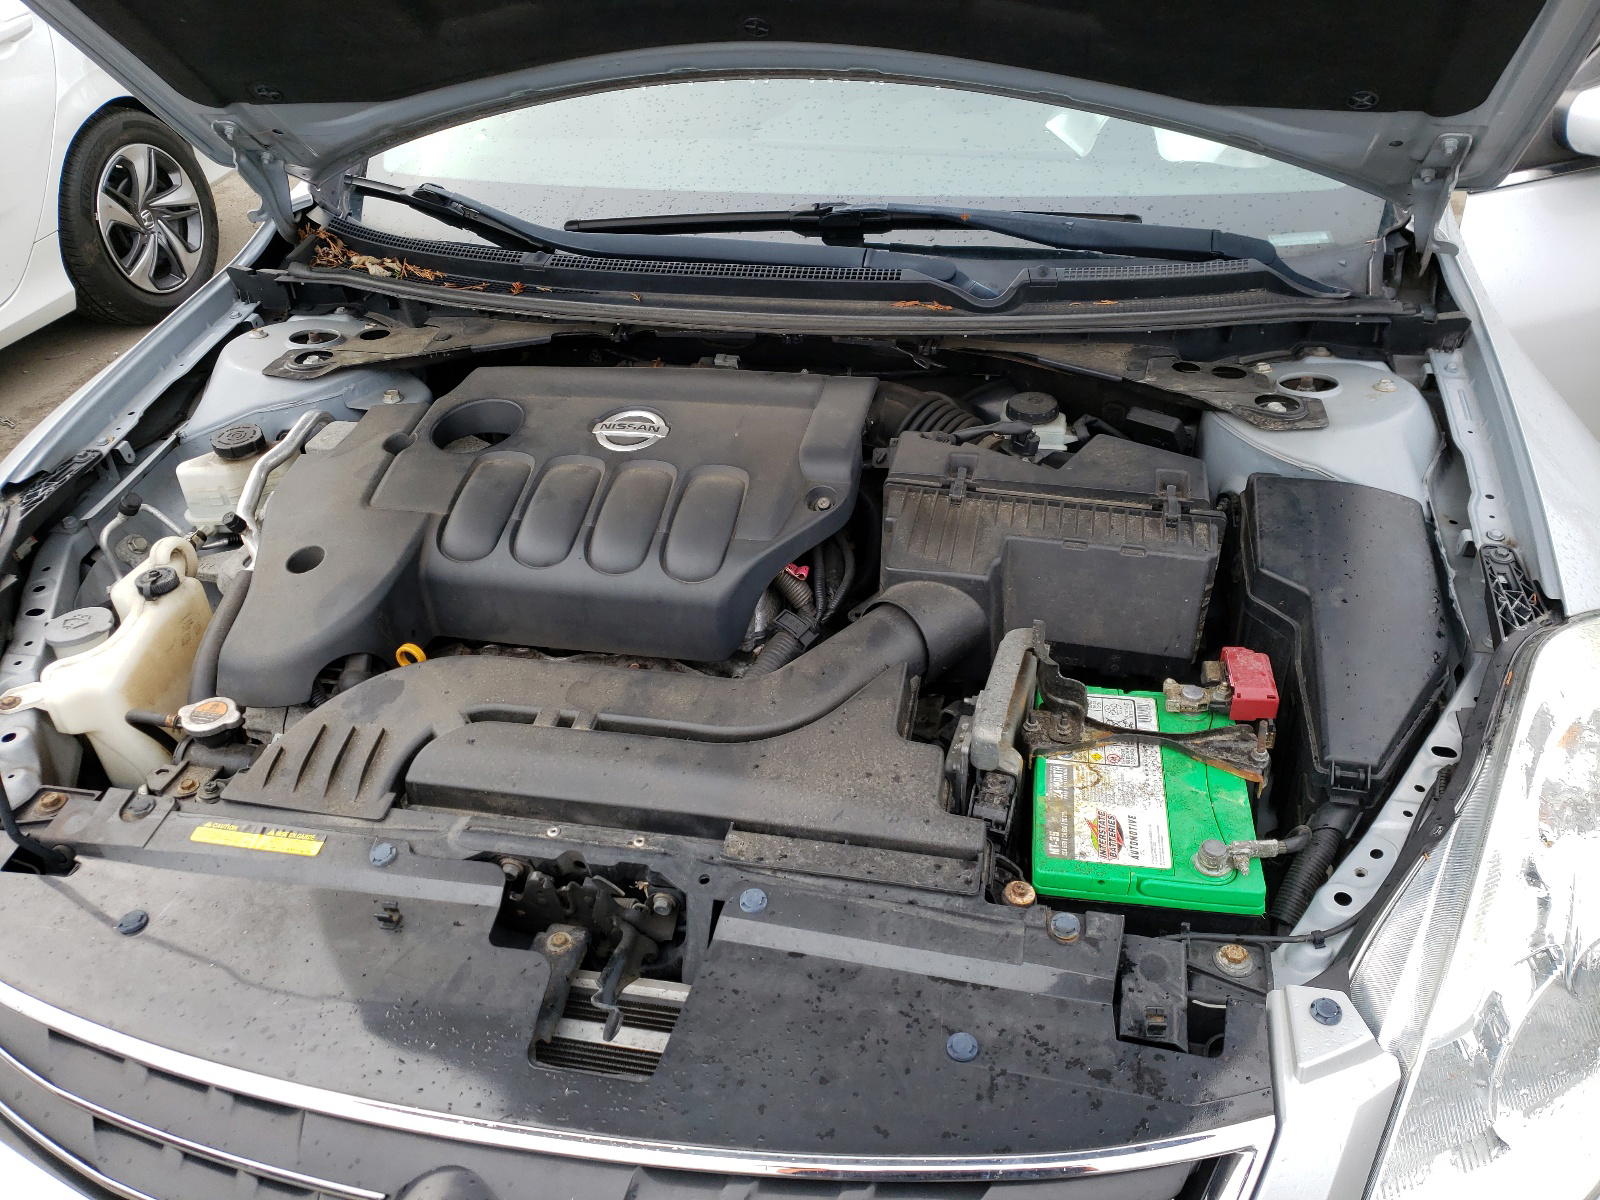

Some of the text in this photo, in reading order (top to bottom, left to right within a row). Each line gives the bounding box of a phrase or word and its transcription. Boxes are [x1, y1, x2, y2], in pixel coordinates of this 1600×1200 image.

[600, 422, 660, 433] NISSAN
[1048, 830, 1060, 855] MT-35
[1098, 810, 1107, 859] INTERSTATE
[1107, 815, 1118, 859] BATTERIES
[1127, 815, 1140, 860] AUTOMOTIVE
